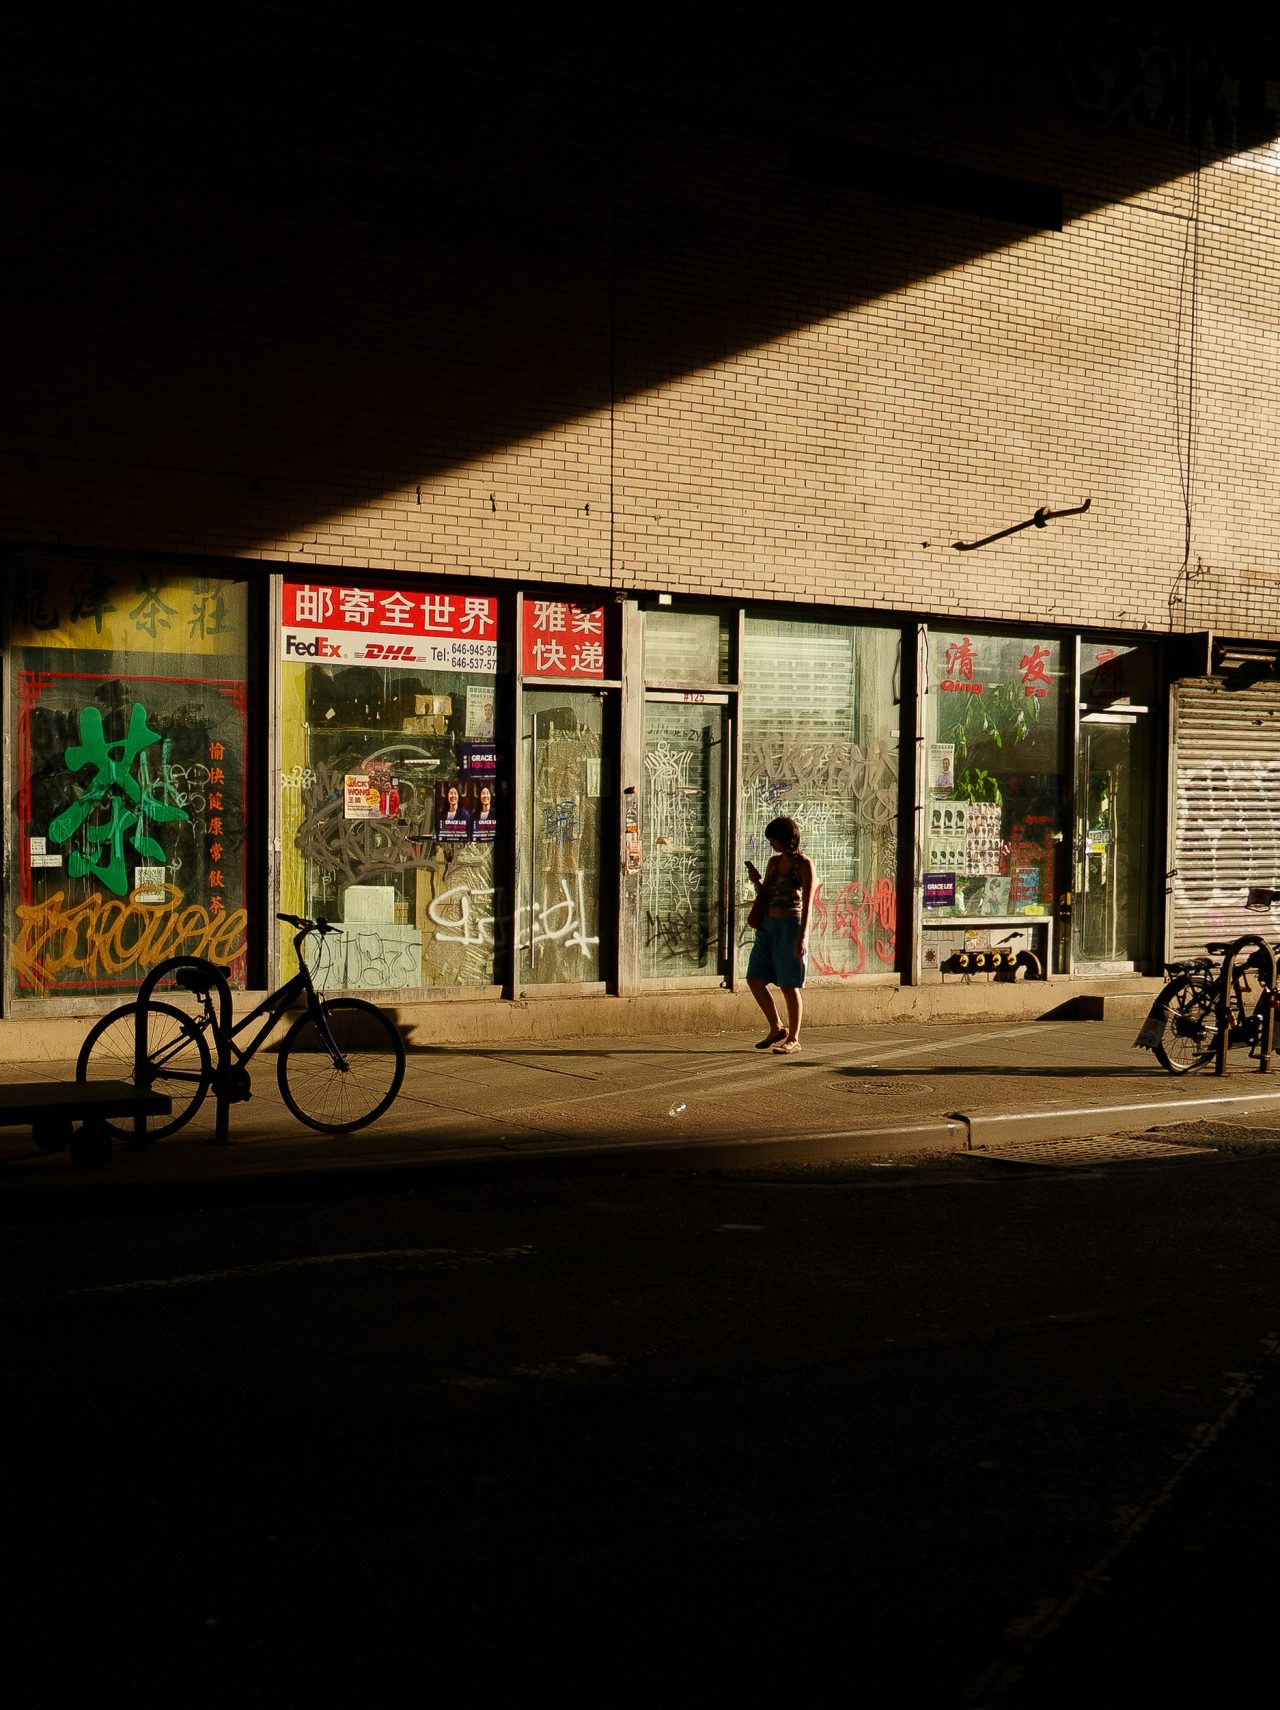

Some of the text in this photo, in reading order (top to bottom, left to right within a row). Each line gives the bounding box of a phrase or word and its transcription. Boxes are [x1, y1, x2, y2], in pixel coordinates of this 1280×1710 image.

[295, 584, 495, 634] 邮寄全世界
[533, 601, 602, 635] 雅柔
[286, 635, 418, 662] FedEx DHL
[431, 643, 497, 662] Tel: 646-945-97
[451, 657, 497, 670] 646-537-57
[532, 638, 604, 673] 快递
[941, 679, 983, 695] Qing
[1025, 686, 1047, 698] Fa
[48, 703, 189, 896] 茶
